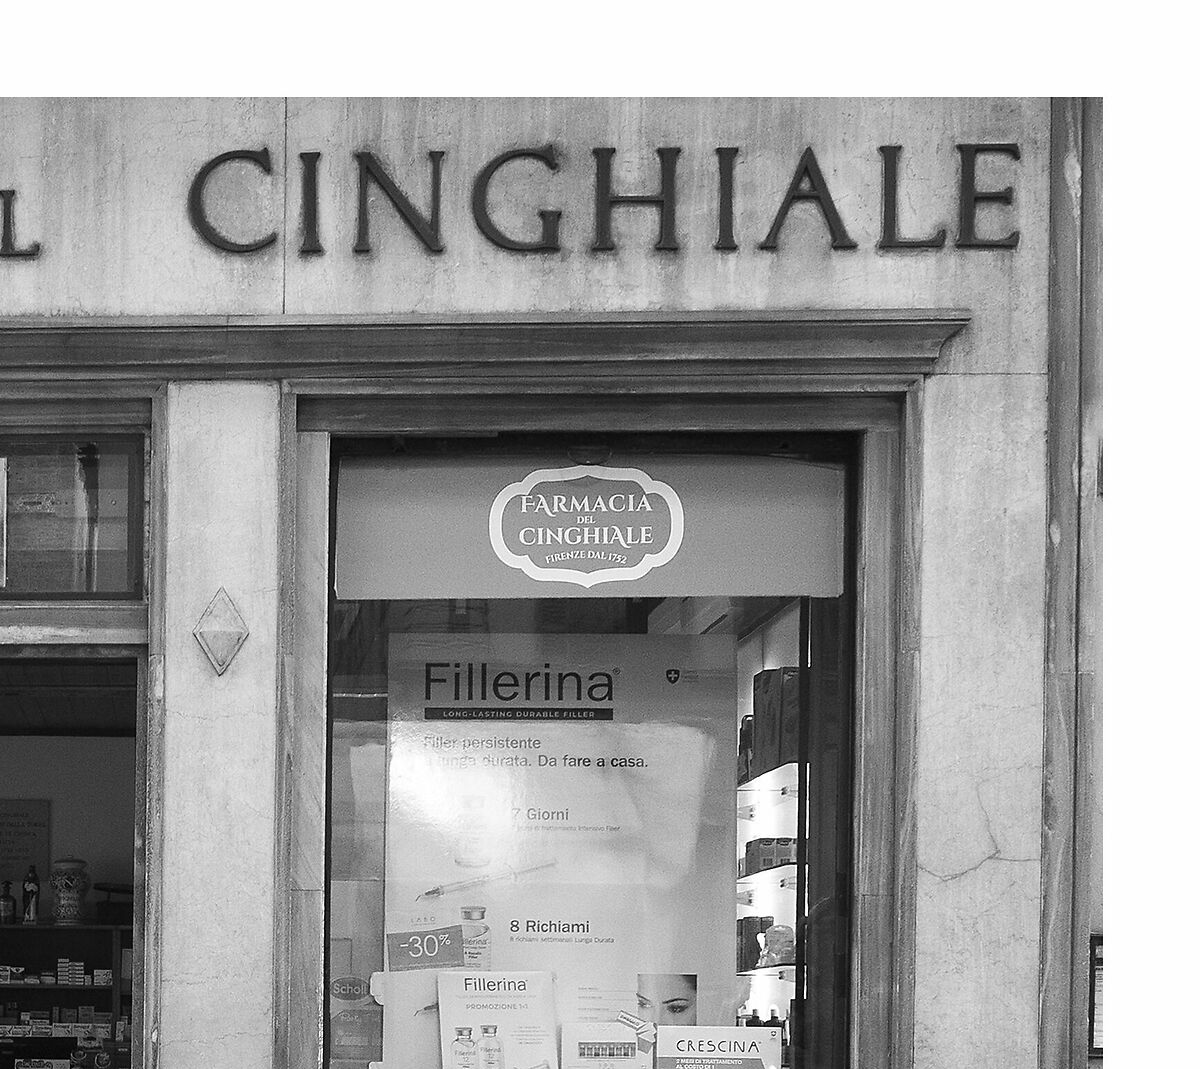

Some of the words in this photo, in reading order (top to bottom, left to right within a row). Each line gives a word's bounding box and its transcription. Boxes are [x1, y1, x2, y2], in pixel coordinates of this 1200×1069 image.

[187, 143, 1020, 257] CINGHIALE
[520, 494, 653, 517] FARMACIA
[576, 516, 596, 524] DEL
[518, 525, 654, 549] CINGHIALE
[545, 551, 585, 564] FIRENZE
[587, 550, 607, 560] DAL
[608, 552, 628, 565] 1752
[443, 710, 513, 719] LONG-LASTING
[515, 710, 560, 719] DURABLE
[563, 710, 595, 719] FILLER
[424, 736, 458, 749] Filler
[462, 736, 541, 751] persistente
[482, 754, 532, 768] durata.
[538, 755, 557, 768] Da
[562, 754, 591, 768] fare
[596, 757, 606, 768] a
[610, 757, 649, 768] casa.
[527, 808, 569, 820] Giorni
[510, 920, 520, 932] 8
[526, 920, 589, 933] Richiami
[399, 934, 451, 957] -30%
[333, 983, 369, 995] Scholl
[464, 978, 527, 991] Fillerina
[676, 1039, 760, 1053] CRESCINA
